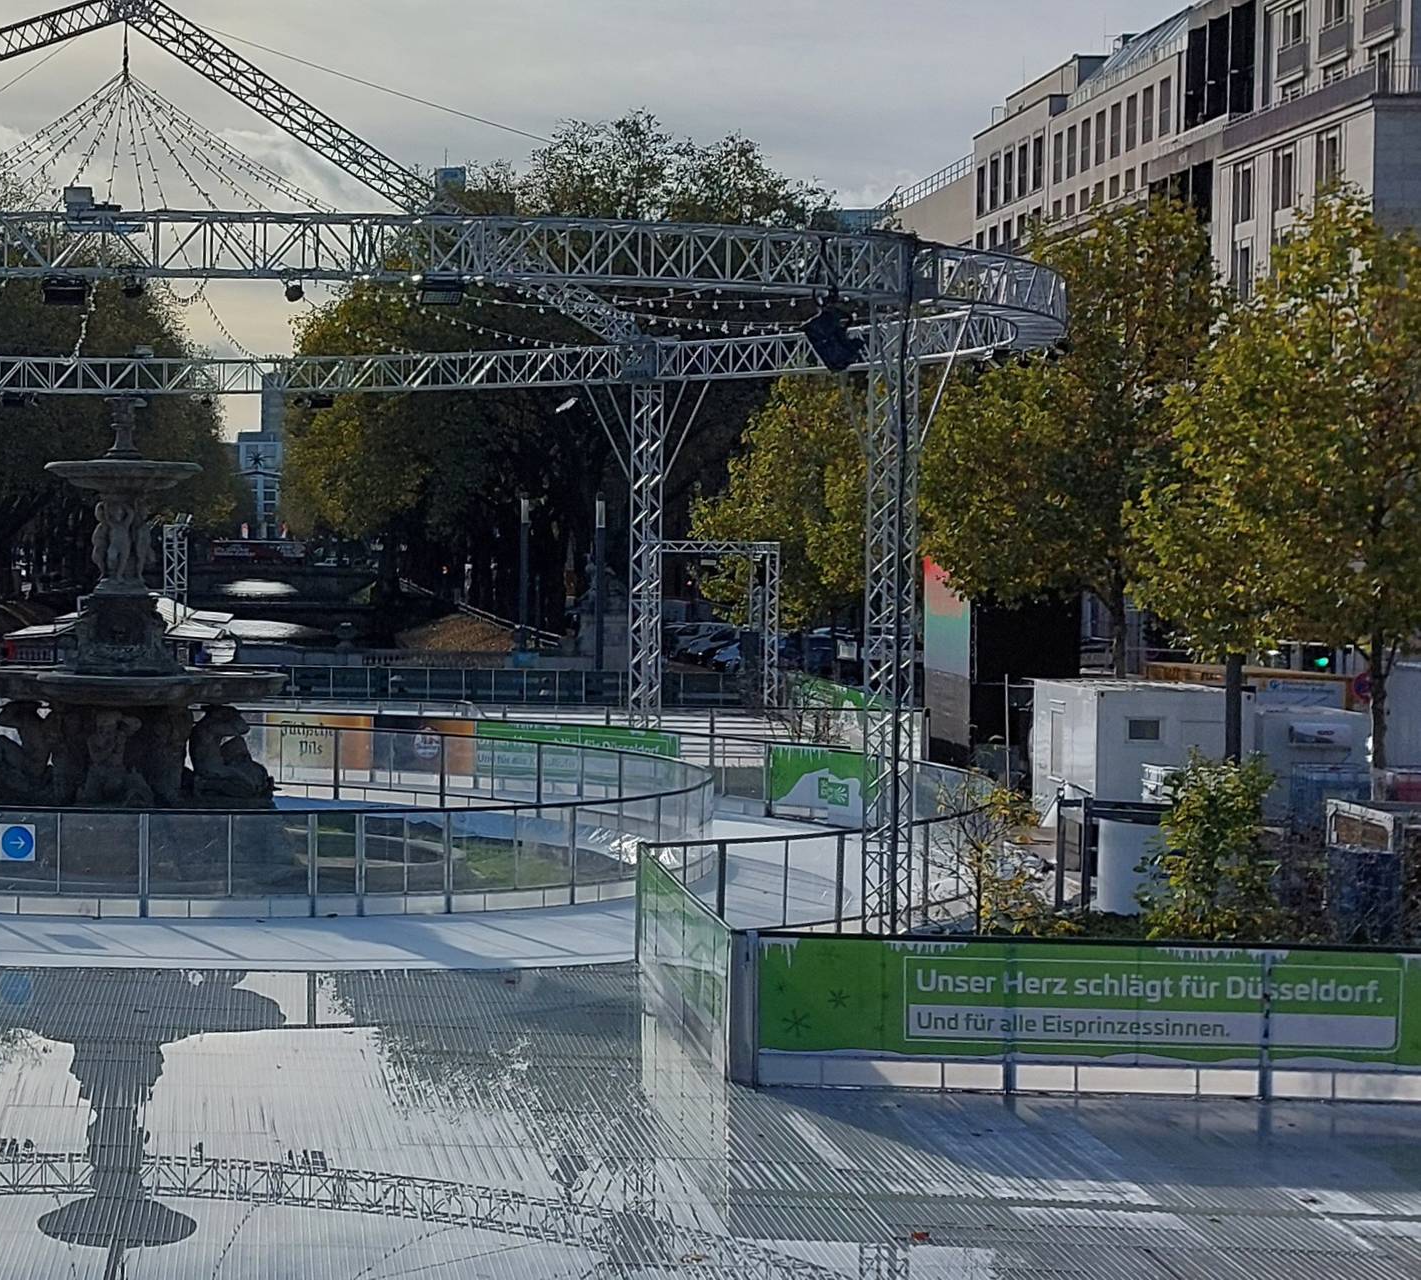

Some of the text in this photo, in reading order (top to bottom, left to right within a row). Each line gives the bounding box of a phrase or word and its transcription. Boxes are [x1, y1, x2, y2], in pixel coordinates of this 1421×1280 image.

[299, 740, 323, 756] Pils
[916, 968, 1383, 1003] Unser Herz schlägt für Düsseldorf.
[917, 1012, 1230, 1038] Und für alle Eisprinzessinnen.
